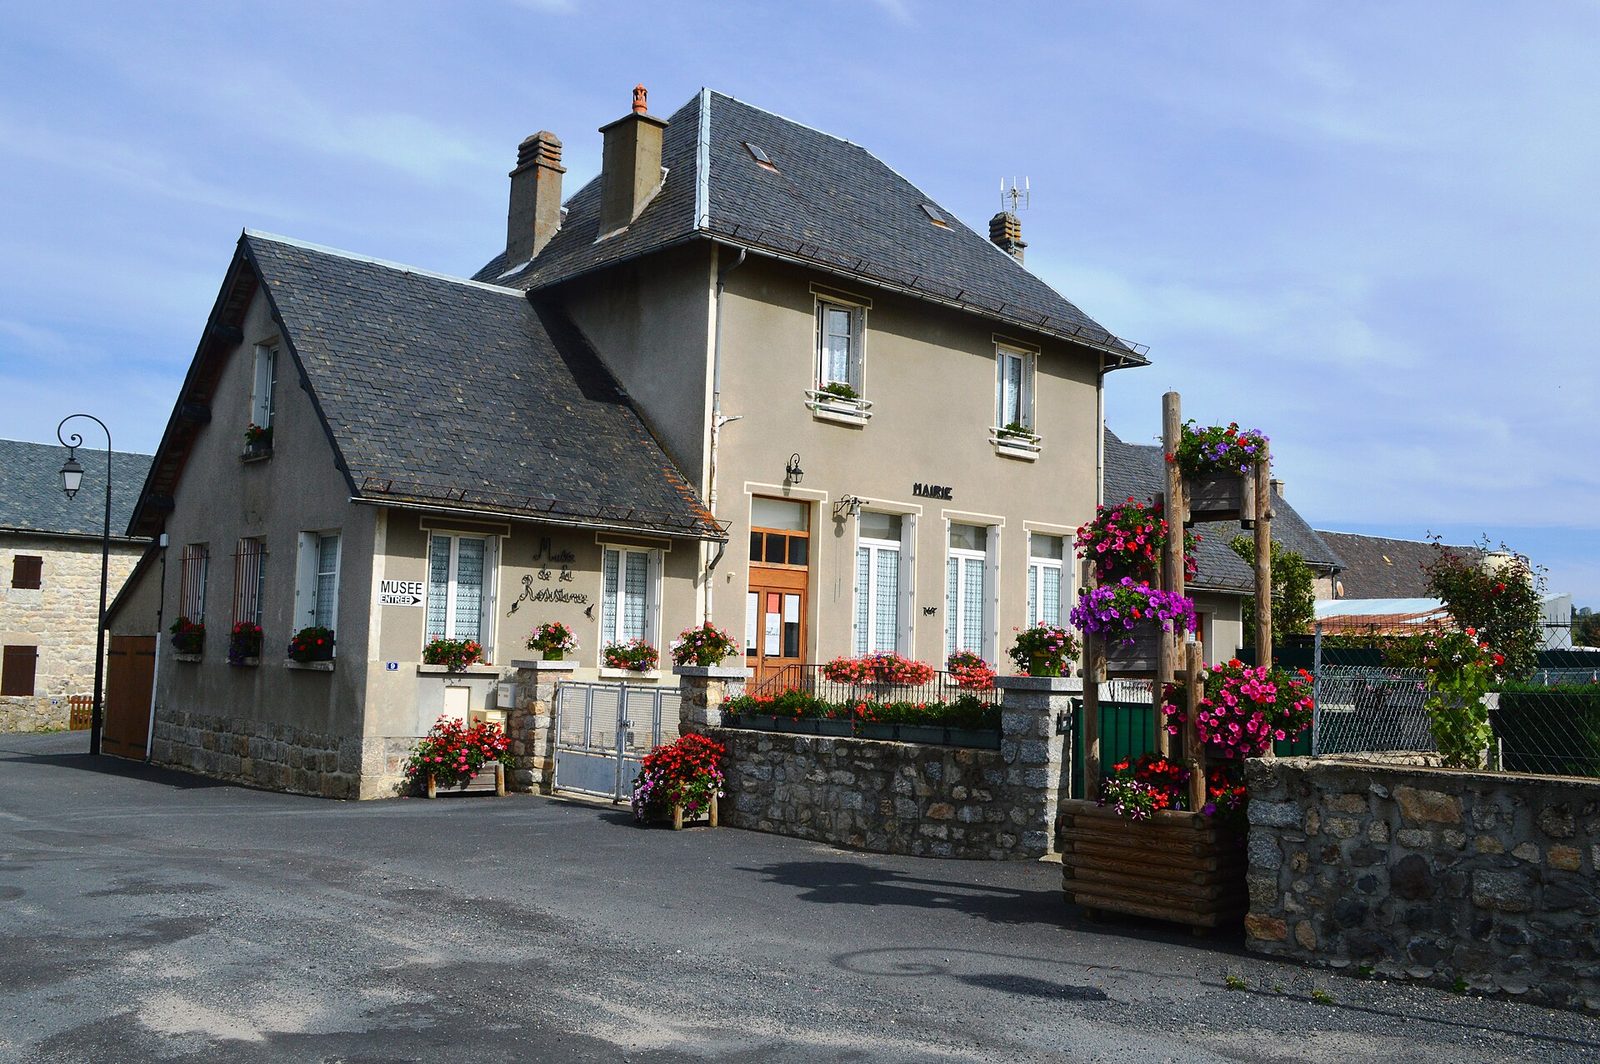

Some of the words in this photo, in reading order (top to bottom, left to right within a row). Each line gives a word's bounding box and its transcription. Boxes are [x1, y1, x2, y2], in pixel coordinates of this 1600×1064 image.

[912, 482, 953, 501] MAIRIE
[380, 580, 422, 595] MUSEE
[380, 594, 410, 604] ENTREE
